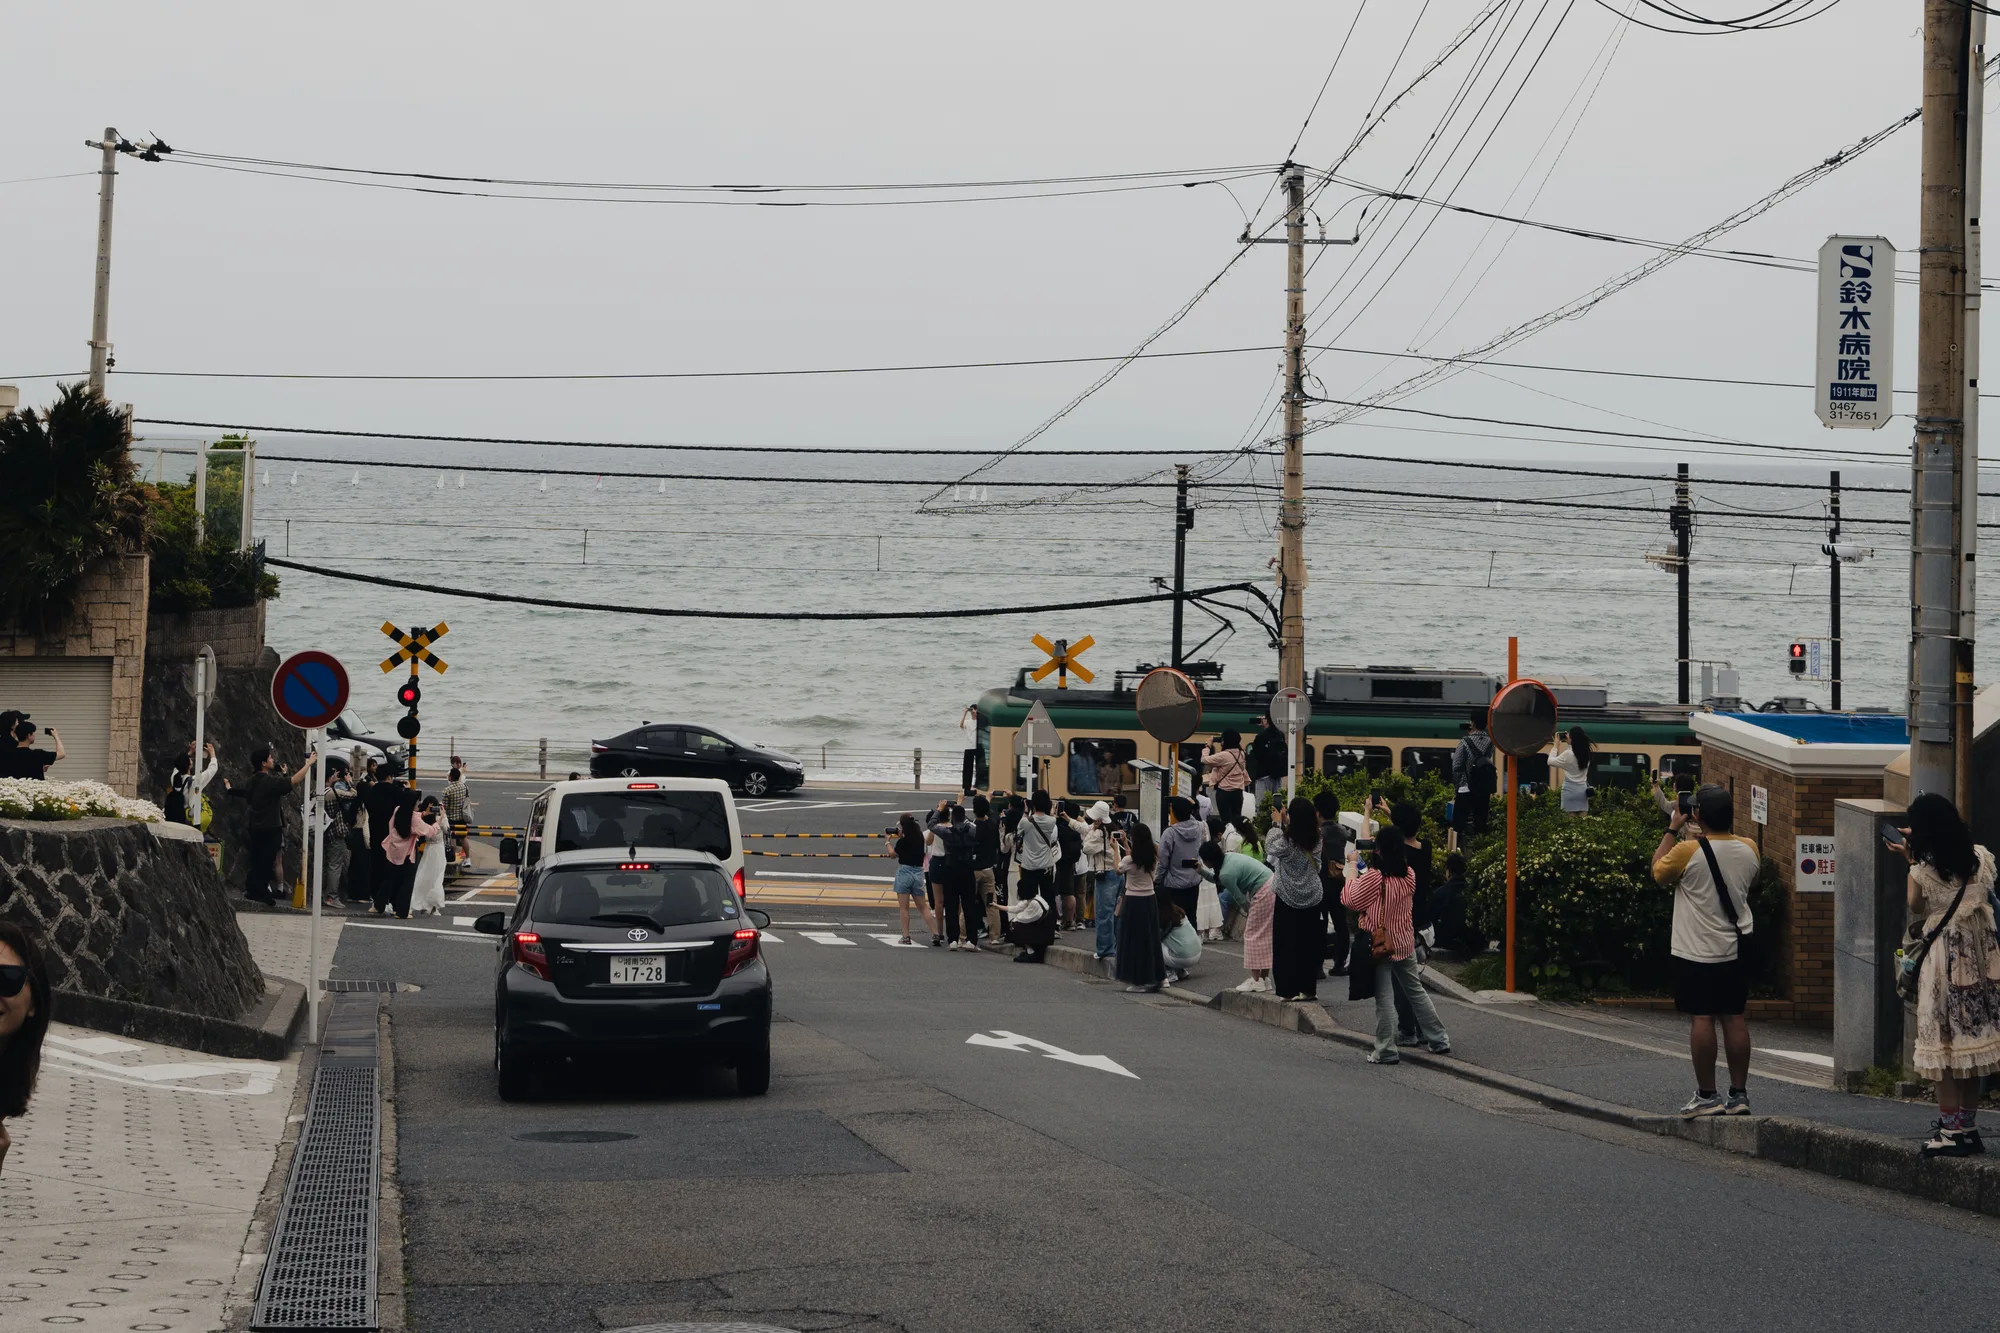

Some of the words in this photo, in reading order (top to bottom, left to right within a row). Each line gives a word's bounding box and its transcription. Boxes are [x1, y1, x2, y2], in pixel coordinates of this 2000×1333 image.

[1838, 280, 1872, 381] 鈴木病院
[1832, 386, 1876, 398] 1911年創立
[1829, 402, 1857, 411] 0467
[1829, 410, 1877, 421] 31-7651
[639, 957, 653, 966] 502
[624, 966, 663, 982] 17-28
